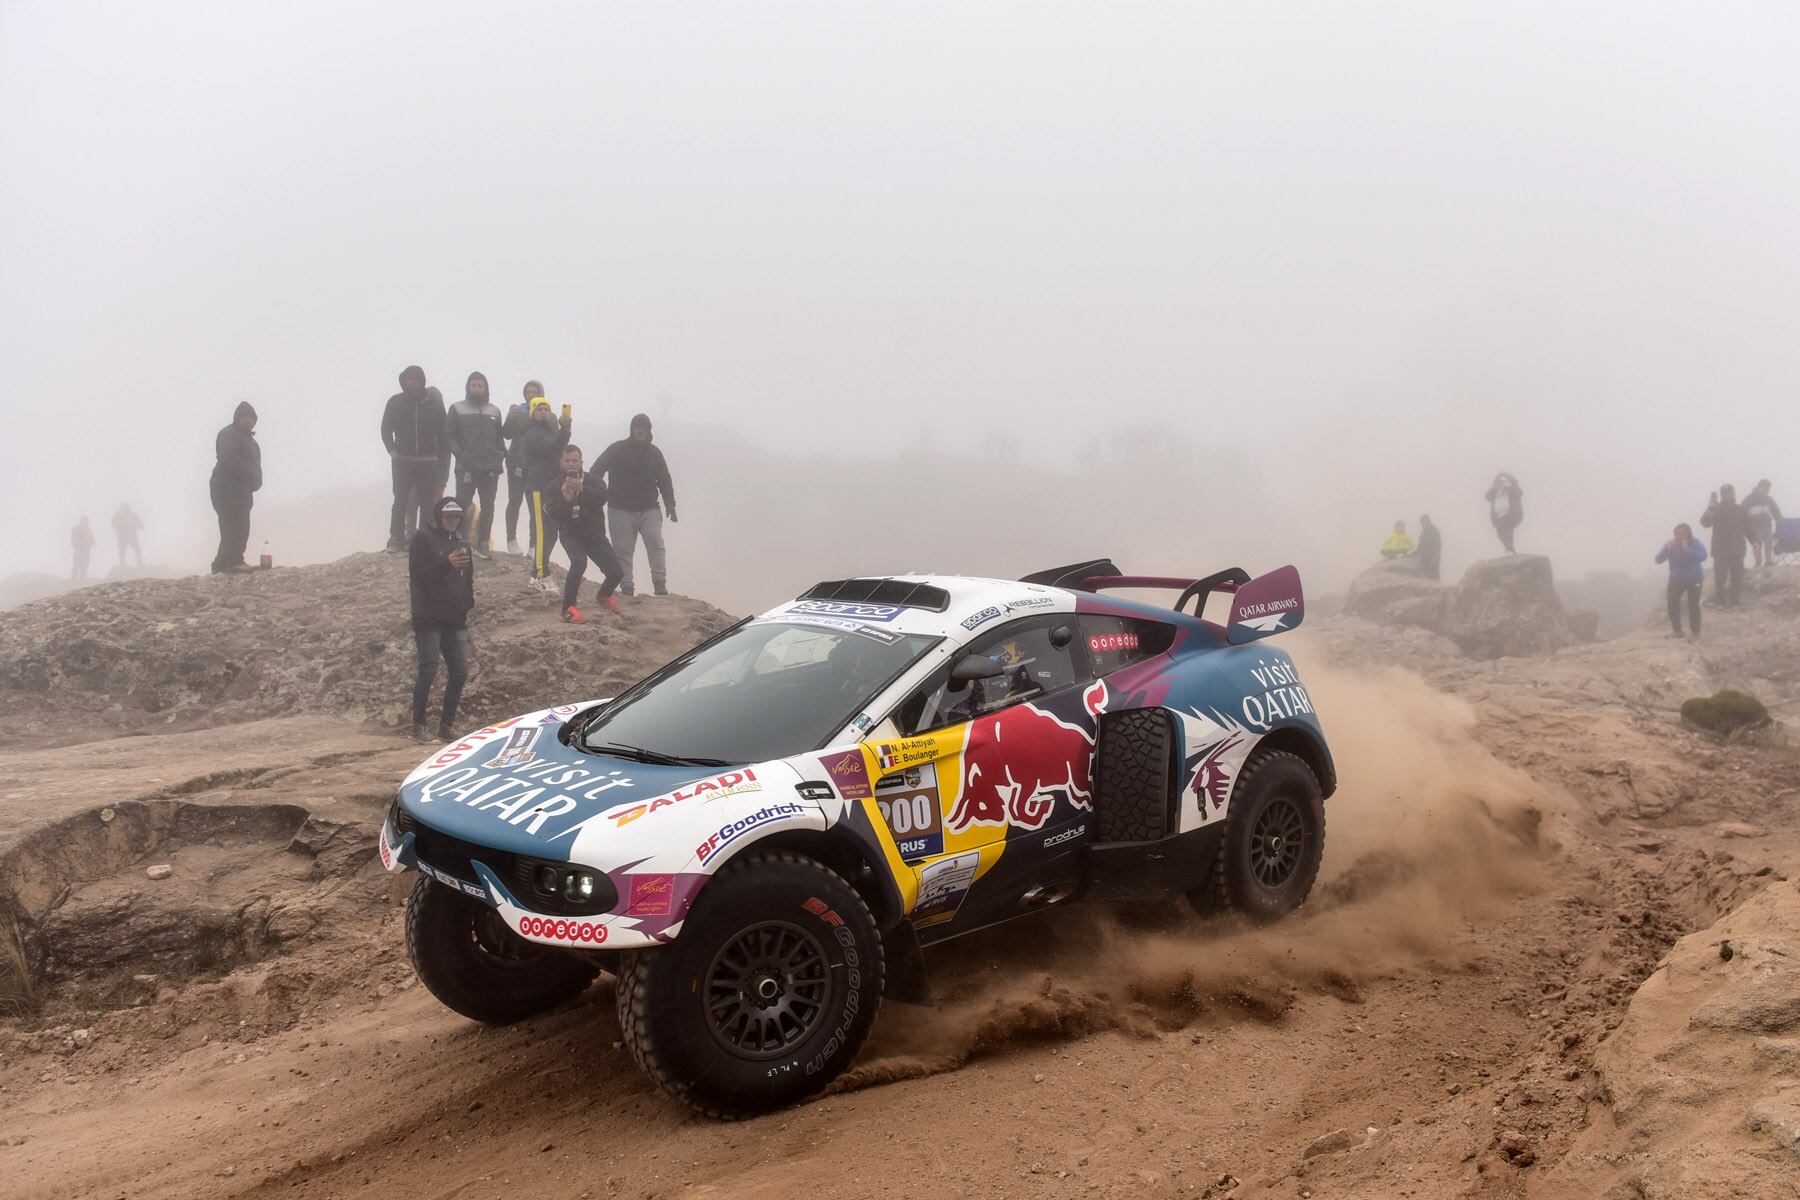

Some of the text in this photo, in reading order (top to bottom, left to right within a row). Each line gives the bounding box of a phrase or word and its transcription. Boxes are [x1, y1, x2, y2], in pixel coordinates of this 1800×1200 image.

[962, 606, 998, 629] sparco
[1239, 597, 1298, 618] QATAR AIRWAYS
[1251, 658, 1298, 688] visit
[1242, 685, 1315, 729] QATAR
[891, 737, 936, 753] N. Al-Attiyah
[893, 748, 939, 765] E. Boulanger
[512, 758, 636, 800] visit
[420, 767, 579, 835] QATAR
[696, 802, 804, 862] BFGoodrich
[519, 916, 608, 943] ooredoo
